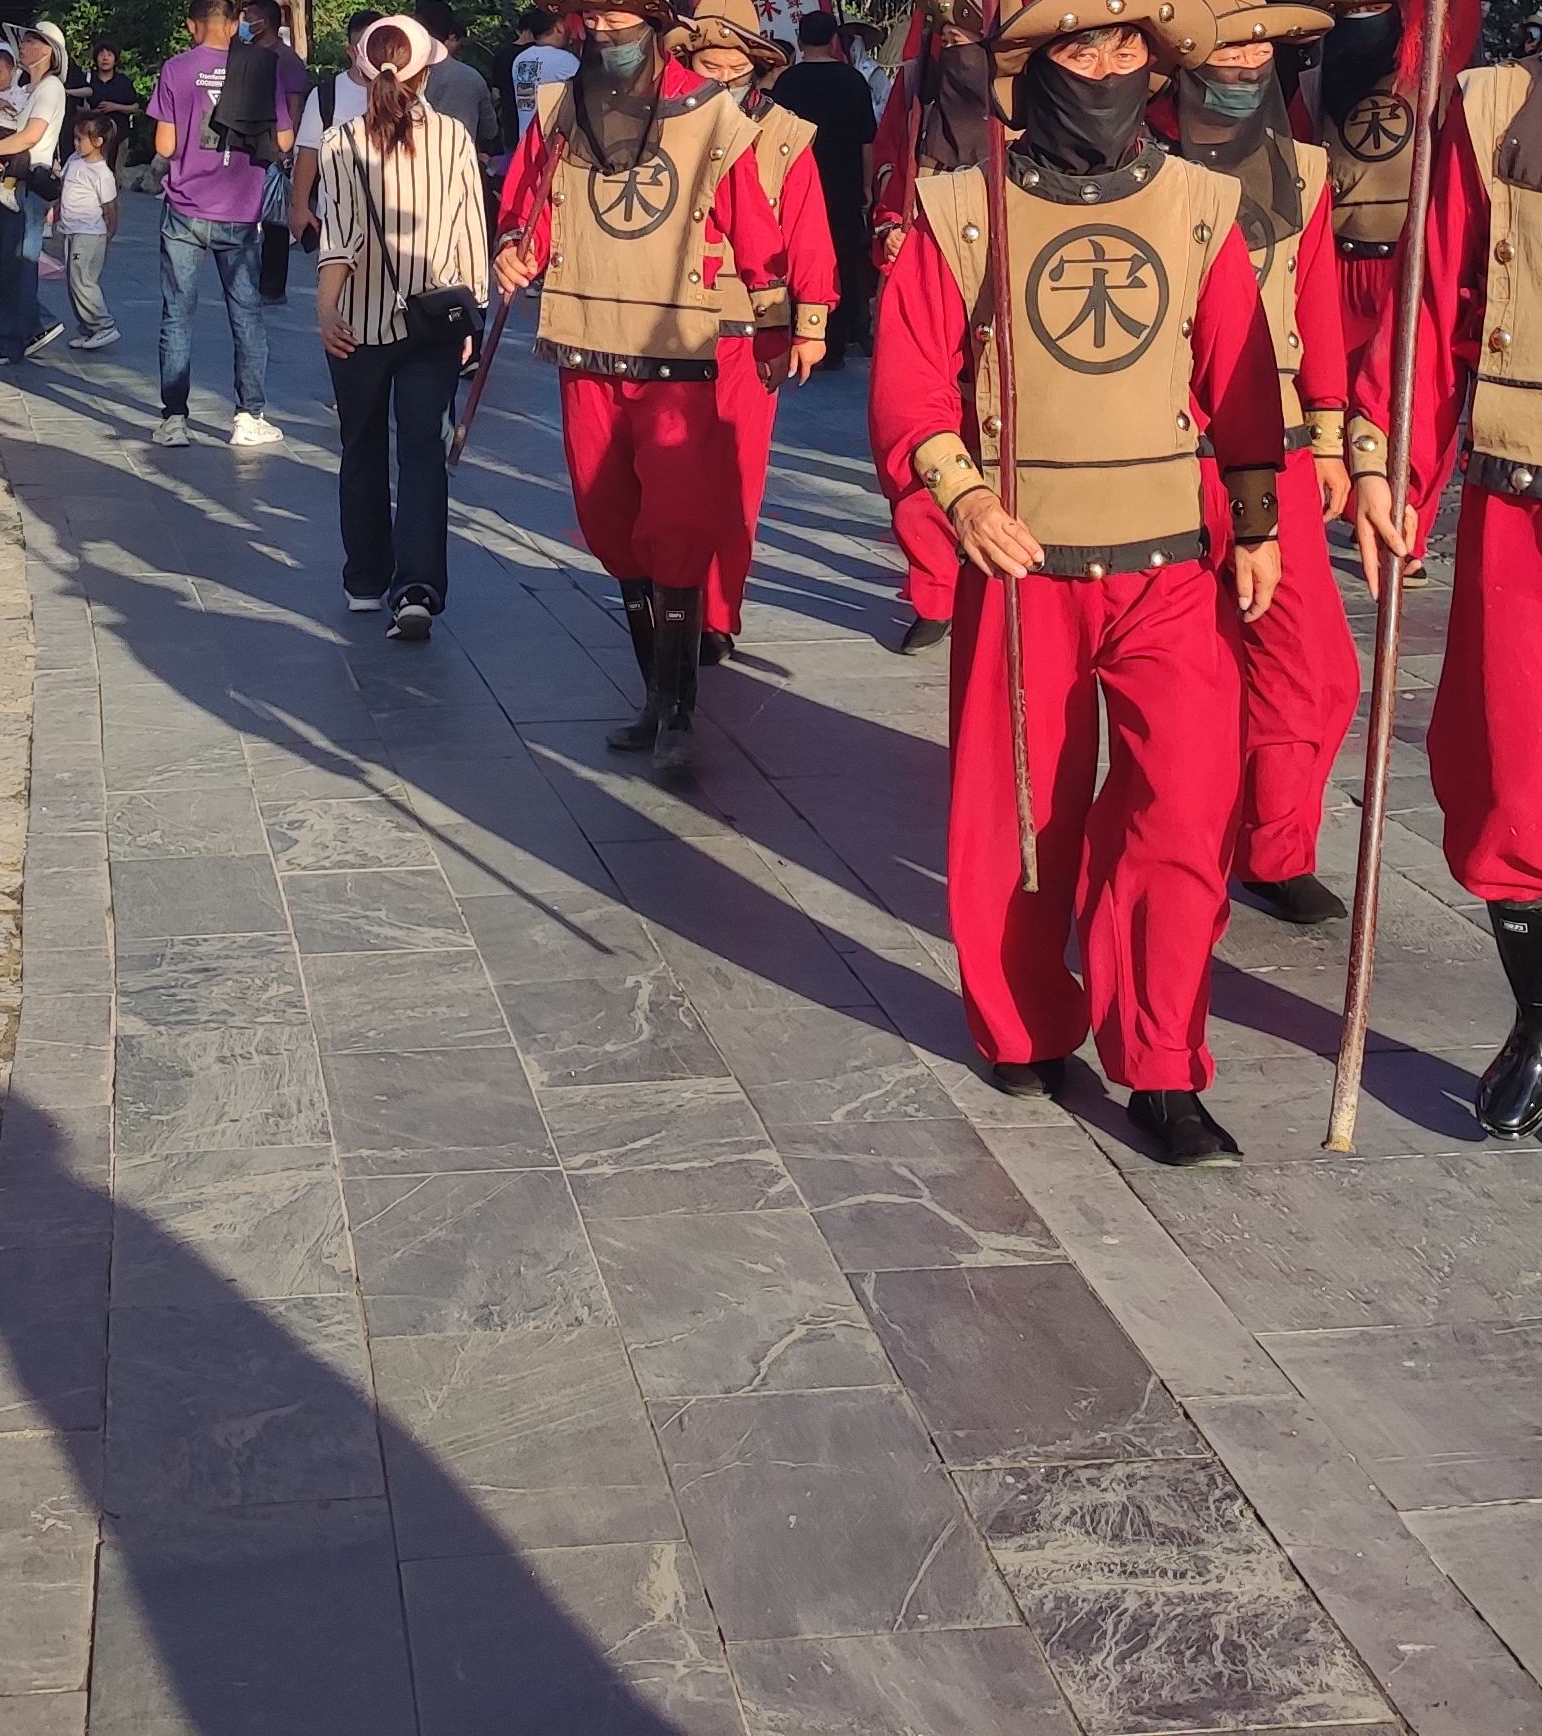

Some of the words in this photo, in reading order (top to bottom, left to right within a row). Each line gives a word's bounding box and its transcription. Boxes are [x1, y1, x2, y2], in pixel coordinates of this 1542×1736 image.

[1349, 98, 1406, 150] 宋
[599, 162, 667, 222] 宋
[1048, 238, 1151, 349] 宋
